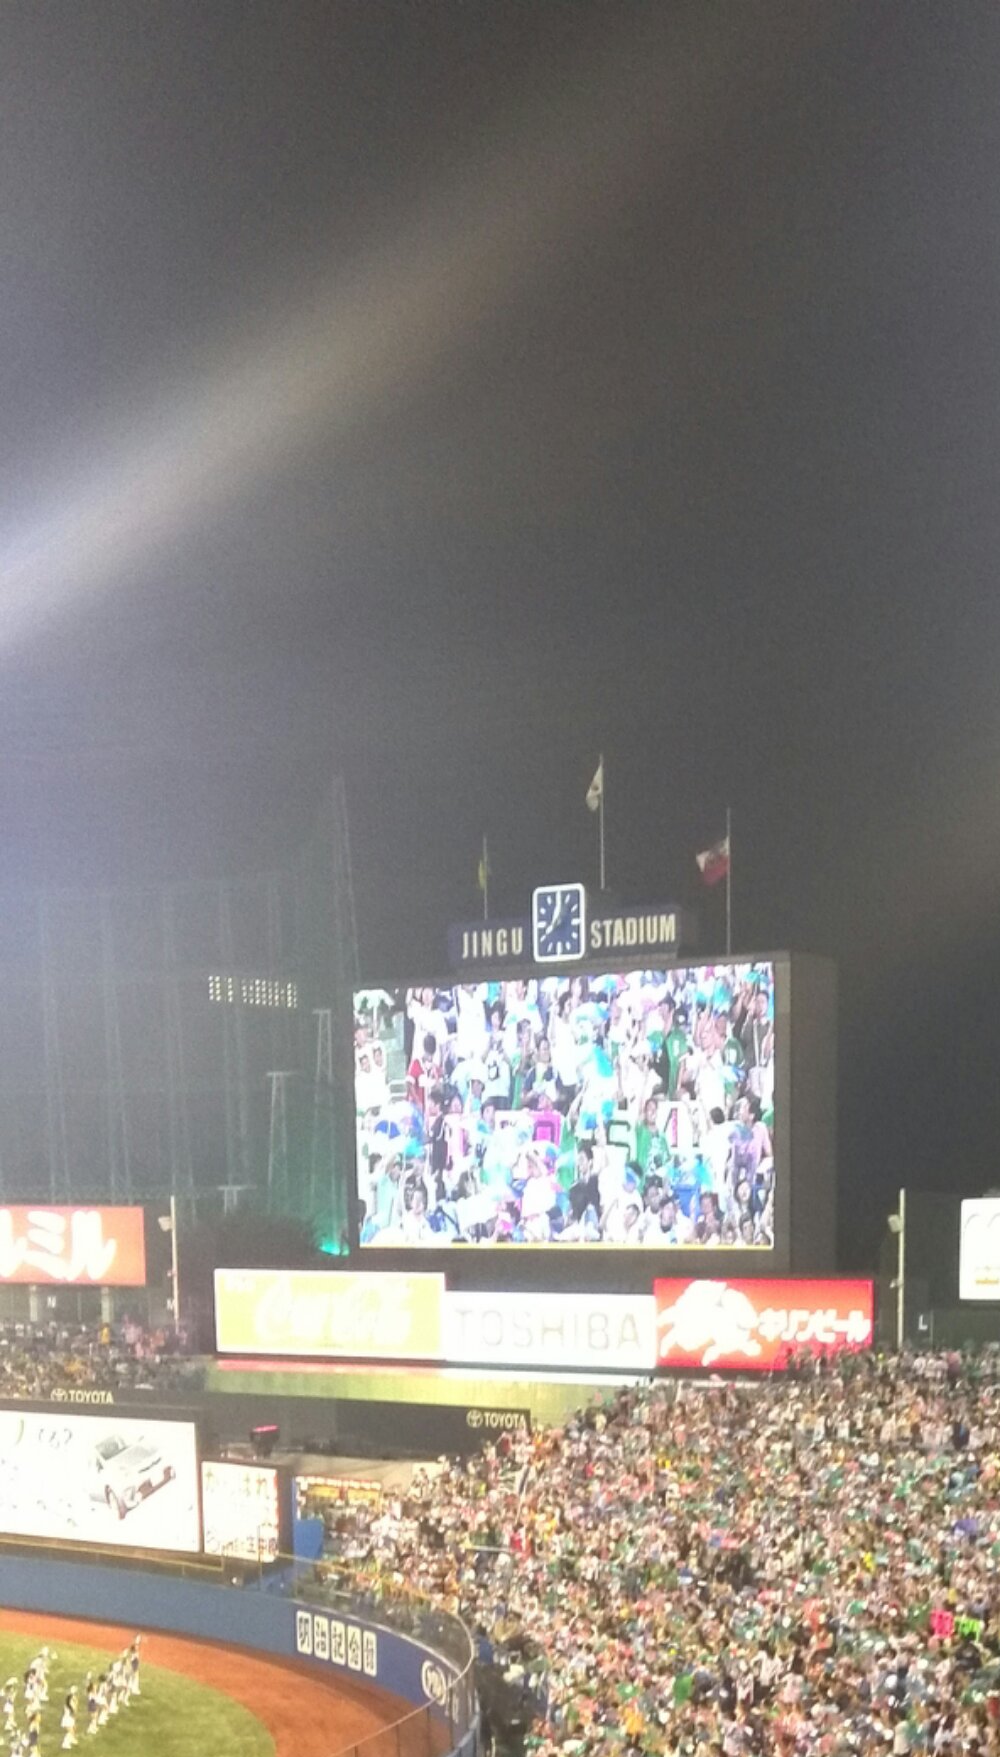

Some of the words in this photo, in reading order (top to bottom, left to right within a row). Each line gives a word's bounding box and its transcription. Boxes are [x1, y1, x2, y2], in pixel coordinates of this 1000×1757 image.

[462, 927, 523, 960] JINGU
[590, 913, 676, 949] STADIUM
[455, 1308, 641, 1351] TOSHIBA
[918, 1314, 928, 1331] L
[68, 1389, 114, 1404] TOYOTA
[483, 1413, 527, 1429] TOYOTA
